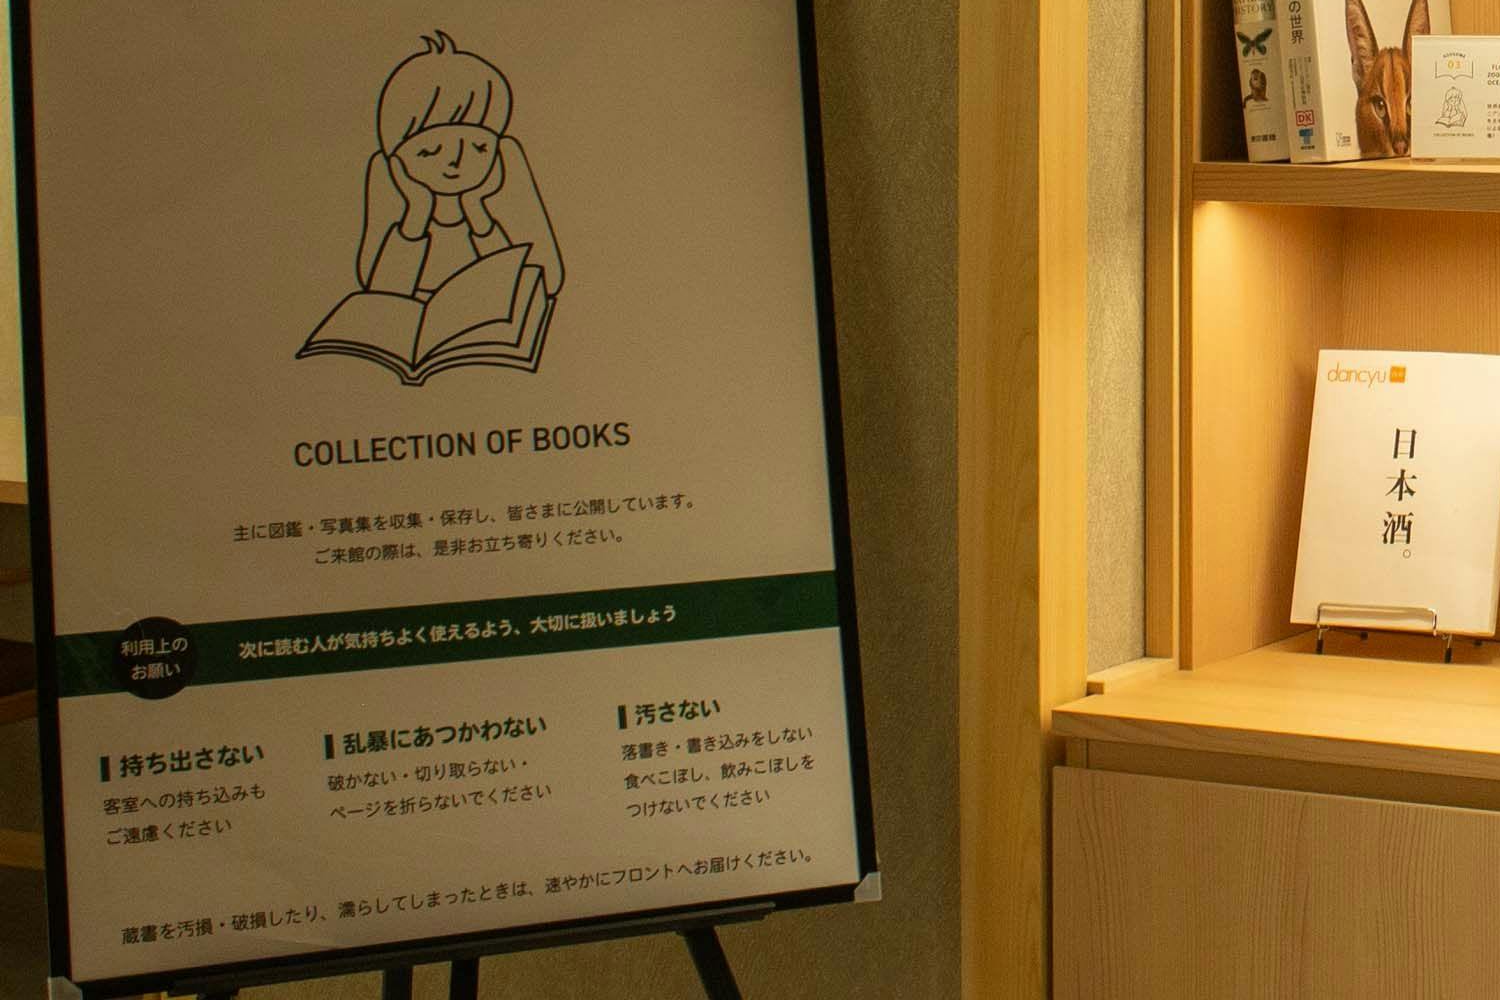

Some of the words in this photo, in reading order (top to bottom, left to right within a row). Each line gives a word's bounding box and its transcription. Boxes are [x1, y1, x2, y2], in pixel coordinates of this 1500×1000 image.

[1327, 362, 1386, 388] dancyu
[294, 431, 476, 467] COLLECTION
[486, 429, 523, 454] OF
[533, 422, 631, 452] BOOKS
[1382, 428, 1417, 559] 日本酒。
[121, 636, 188, 656] 利用上の
[239, 605, 677, 658] 次に読む人が気持ちよく使えるよう、大切に扱いましょう
[130, 663, 181, 681] お願い
[635, 699, 720, 726] 汚さない
[343, 716, 547, 755] 乱暴にあつかわない
[621, 727, 813, 760] 落書き・書き込みをしない
[120, 743, 264, 778] 持ち出さない
[623, 755, 815, 789] 食べこぼし、飲みこぼしを
[103, 784, 266, 816] 客室への持ち込みも
[329, 785, 552, 819] ページを折らないでください
[627, 789, 770, 817] つけないでください
[105, 819, 232, 847] ご遠慮ください
